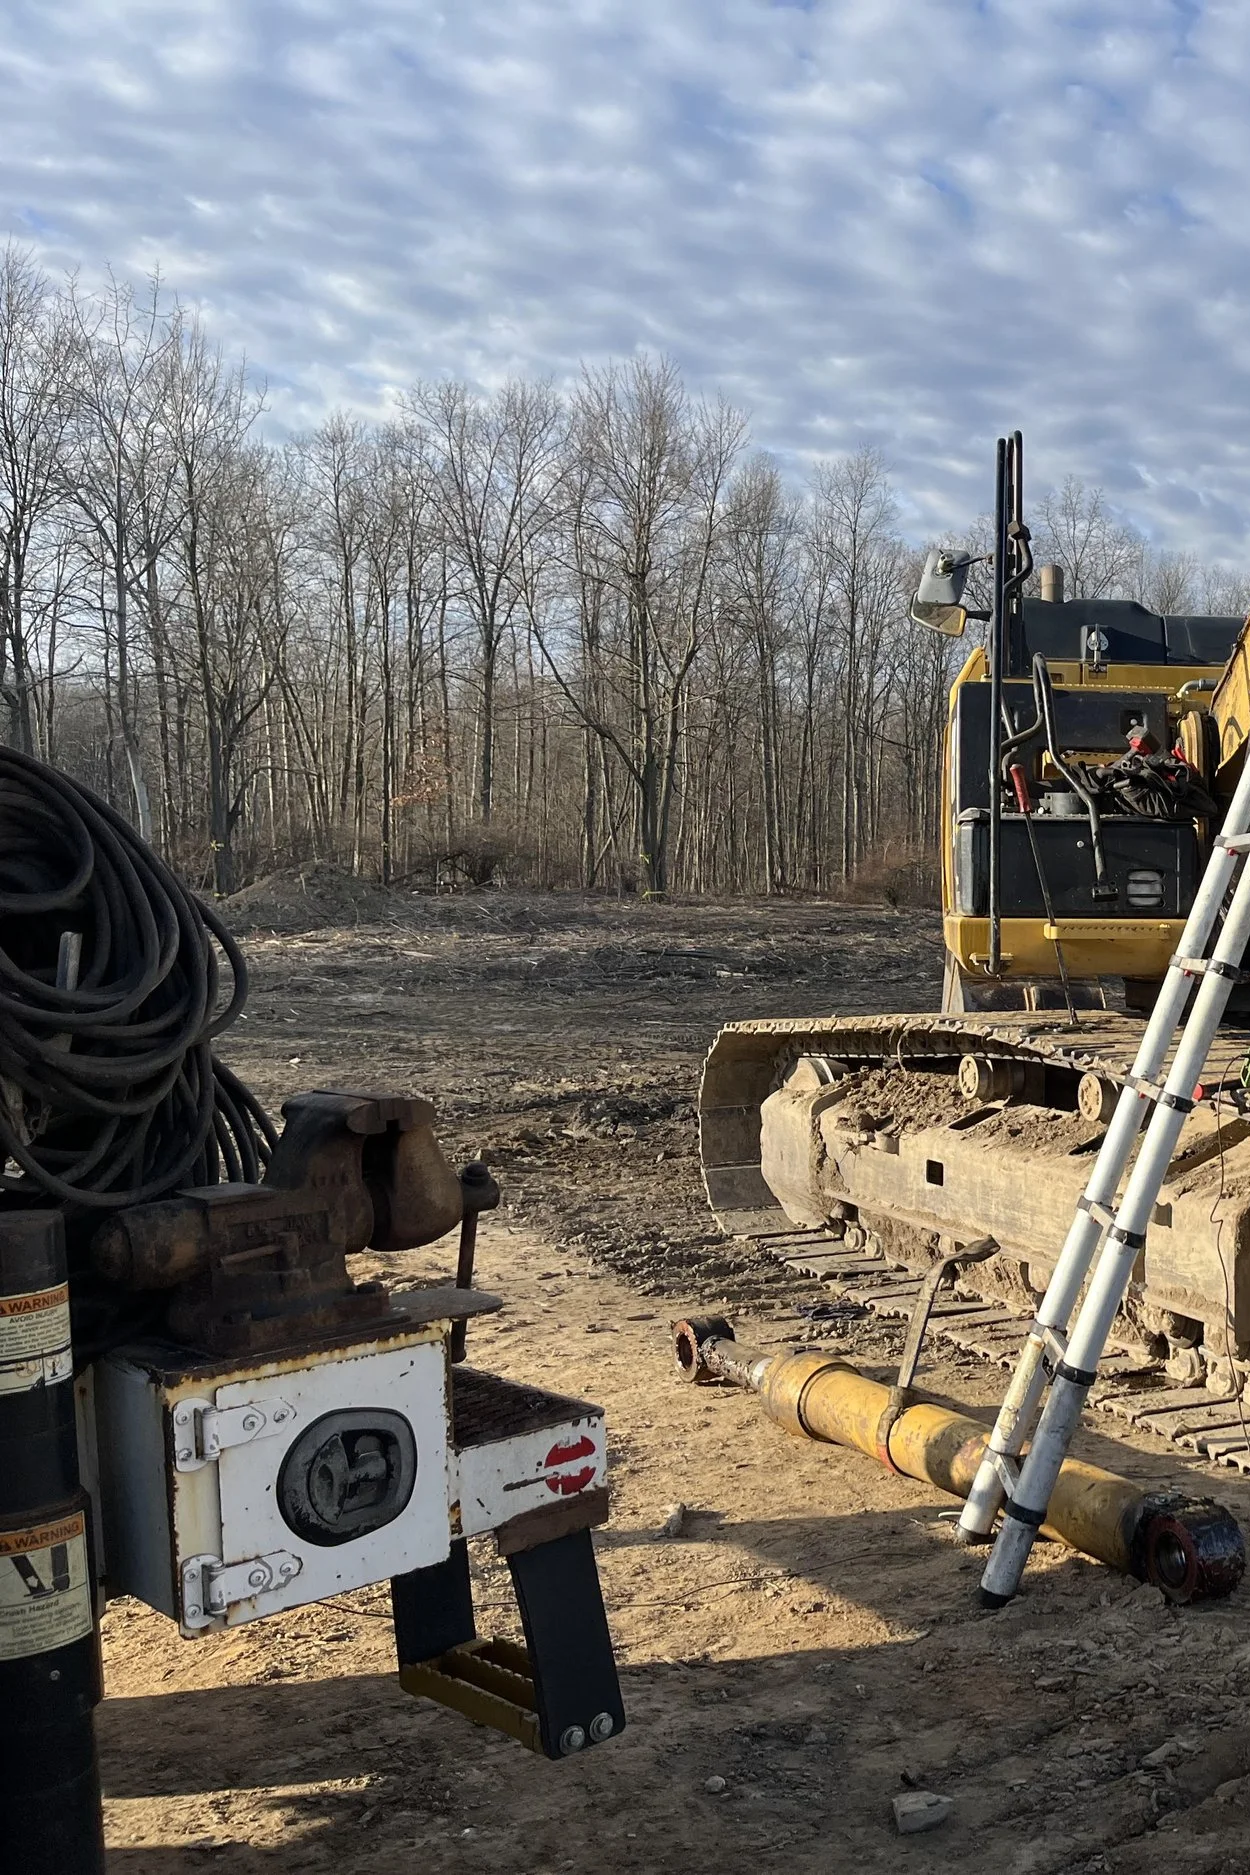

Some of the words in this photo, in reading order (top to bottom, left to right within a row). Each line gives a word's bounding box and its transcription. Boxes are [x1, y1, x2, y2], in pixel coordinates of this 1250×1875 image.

[9, 1291, 65, 1313] WARNING
[9, 1314, 34, 1324] AVOID
[15, 1522, 80, 1548] WARNING
[28, 1599, 60, 1613] Hazard
